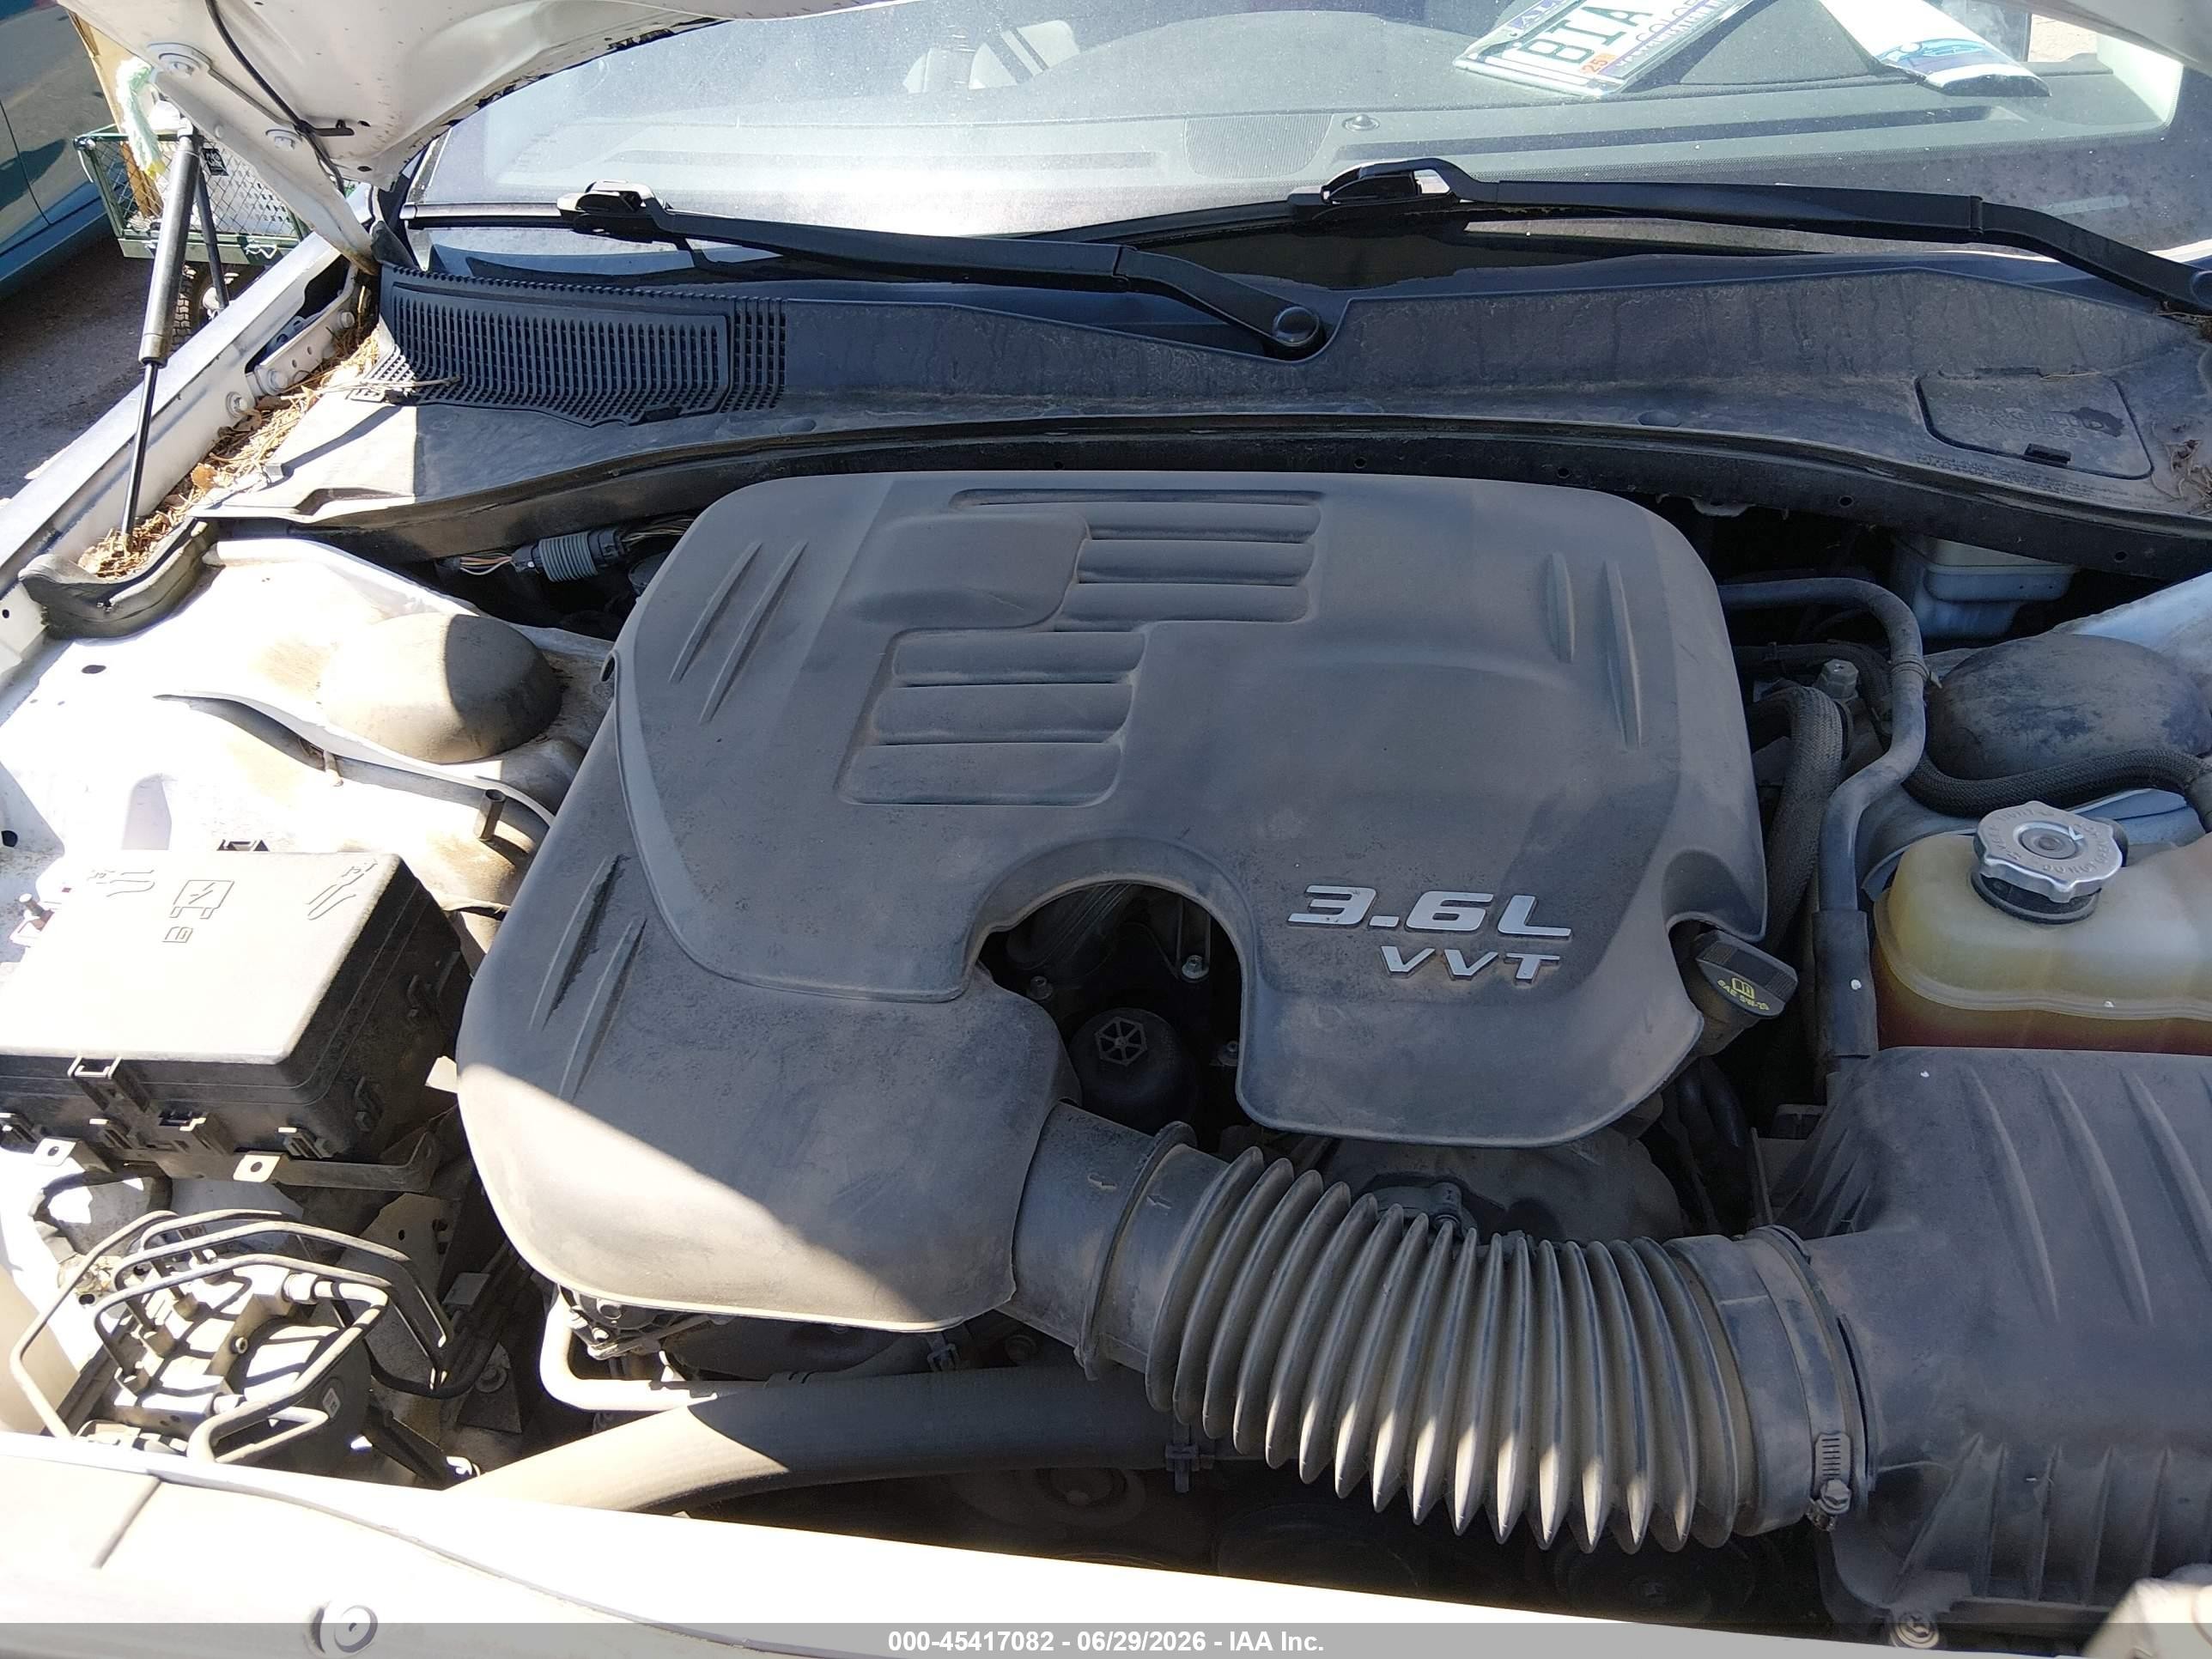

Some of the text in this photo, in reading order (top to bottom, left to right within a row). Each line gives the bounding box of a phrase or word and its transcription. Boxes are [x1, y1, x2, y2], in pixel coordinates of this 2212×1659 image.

[1517, 6, 1653, 64] BIA
[1582, 58, 1608, 73] 25
[1288, 884, 1572, 939] 3.6L
[1381, 945, 1560, 982] VVT
